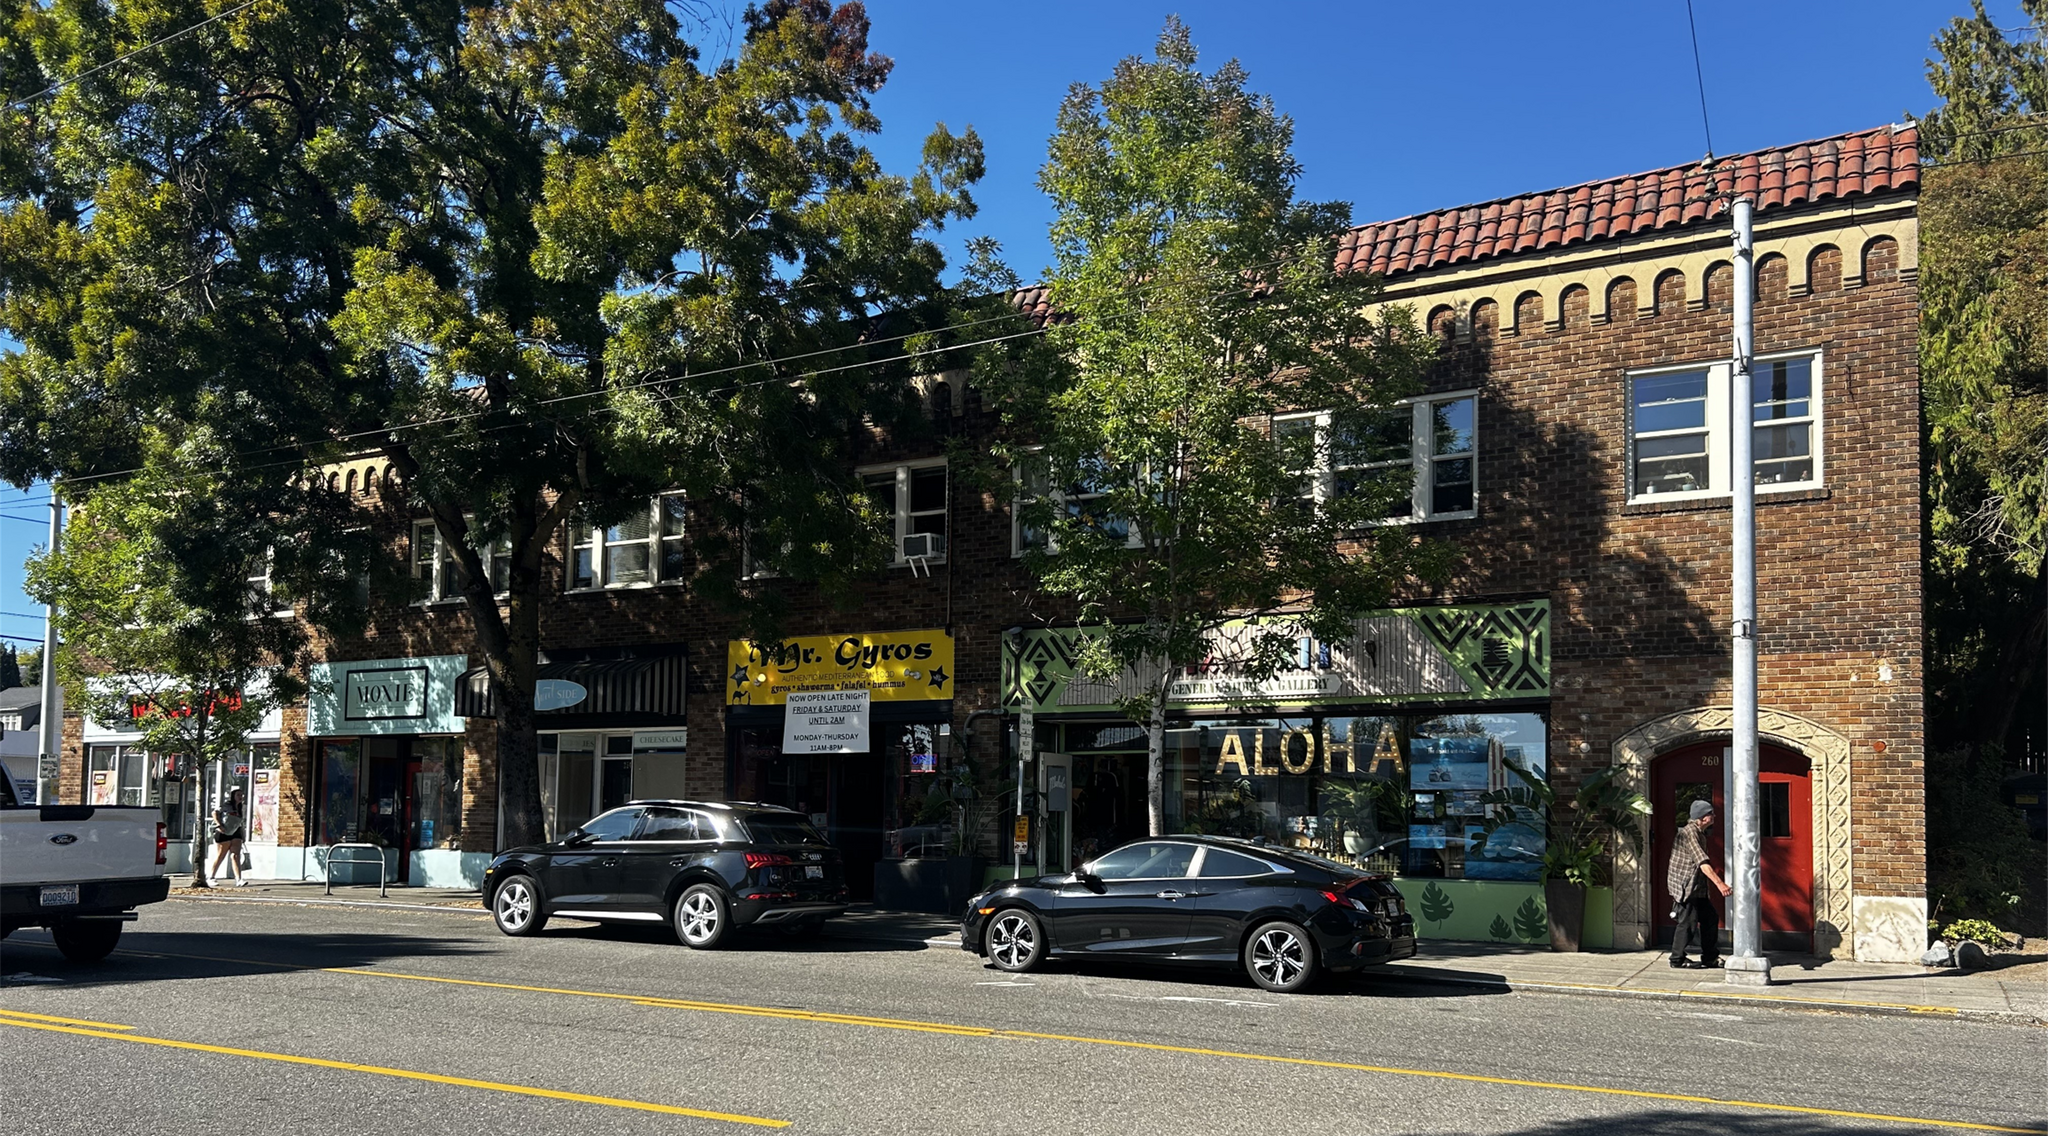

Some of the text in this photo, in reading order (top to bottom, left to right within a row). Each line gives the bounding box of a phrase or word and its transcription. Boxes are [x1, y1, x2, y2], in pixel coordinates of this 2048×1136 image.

[749, 637, 933, 674] Mr. Gyros
[782, 670, 896, 683] AUTHENTIC MEDITERRANEAN FOOD
[771, 684, 792, 695] gyros
[840, 680, 866, 691] falafel
[872, 679, 906, 689] hummus
[1171, 681, 1222, 696] GENERAL
[1277, 677, 1331, 692] GALLERY
[356, 683, 414, 704] MOXIE
[556, 688, 578, 700] SIDE
[789, 692, 868, 703] NOW OPEN LATE NIGHT
[792, 703, 862, 714] FRIDAY & SATURDAY
[808, 716, 846, 725] UNTIL 2AM
[639, 735, 684, 744] CHEESECAKE
[793, 733, 859, 742] MONDAY-THURSDAY
[810, 744, 844, 752] 11AM-8PM
[1214, 721, 1406, 776] ALOHA
[911, 755, 936, 765] OPEN
[1701, 755, 1719, 767] 260
[235, 765, 250, 775] OPE
